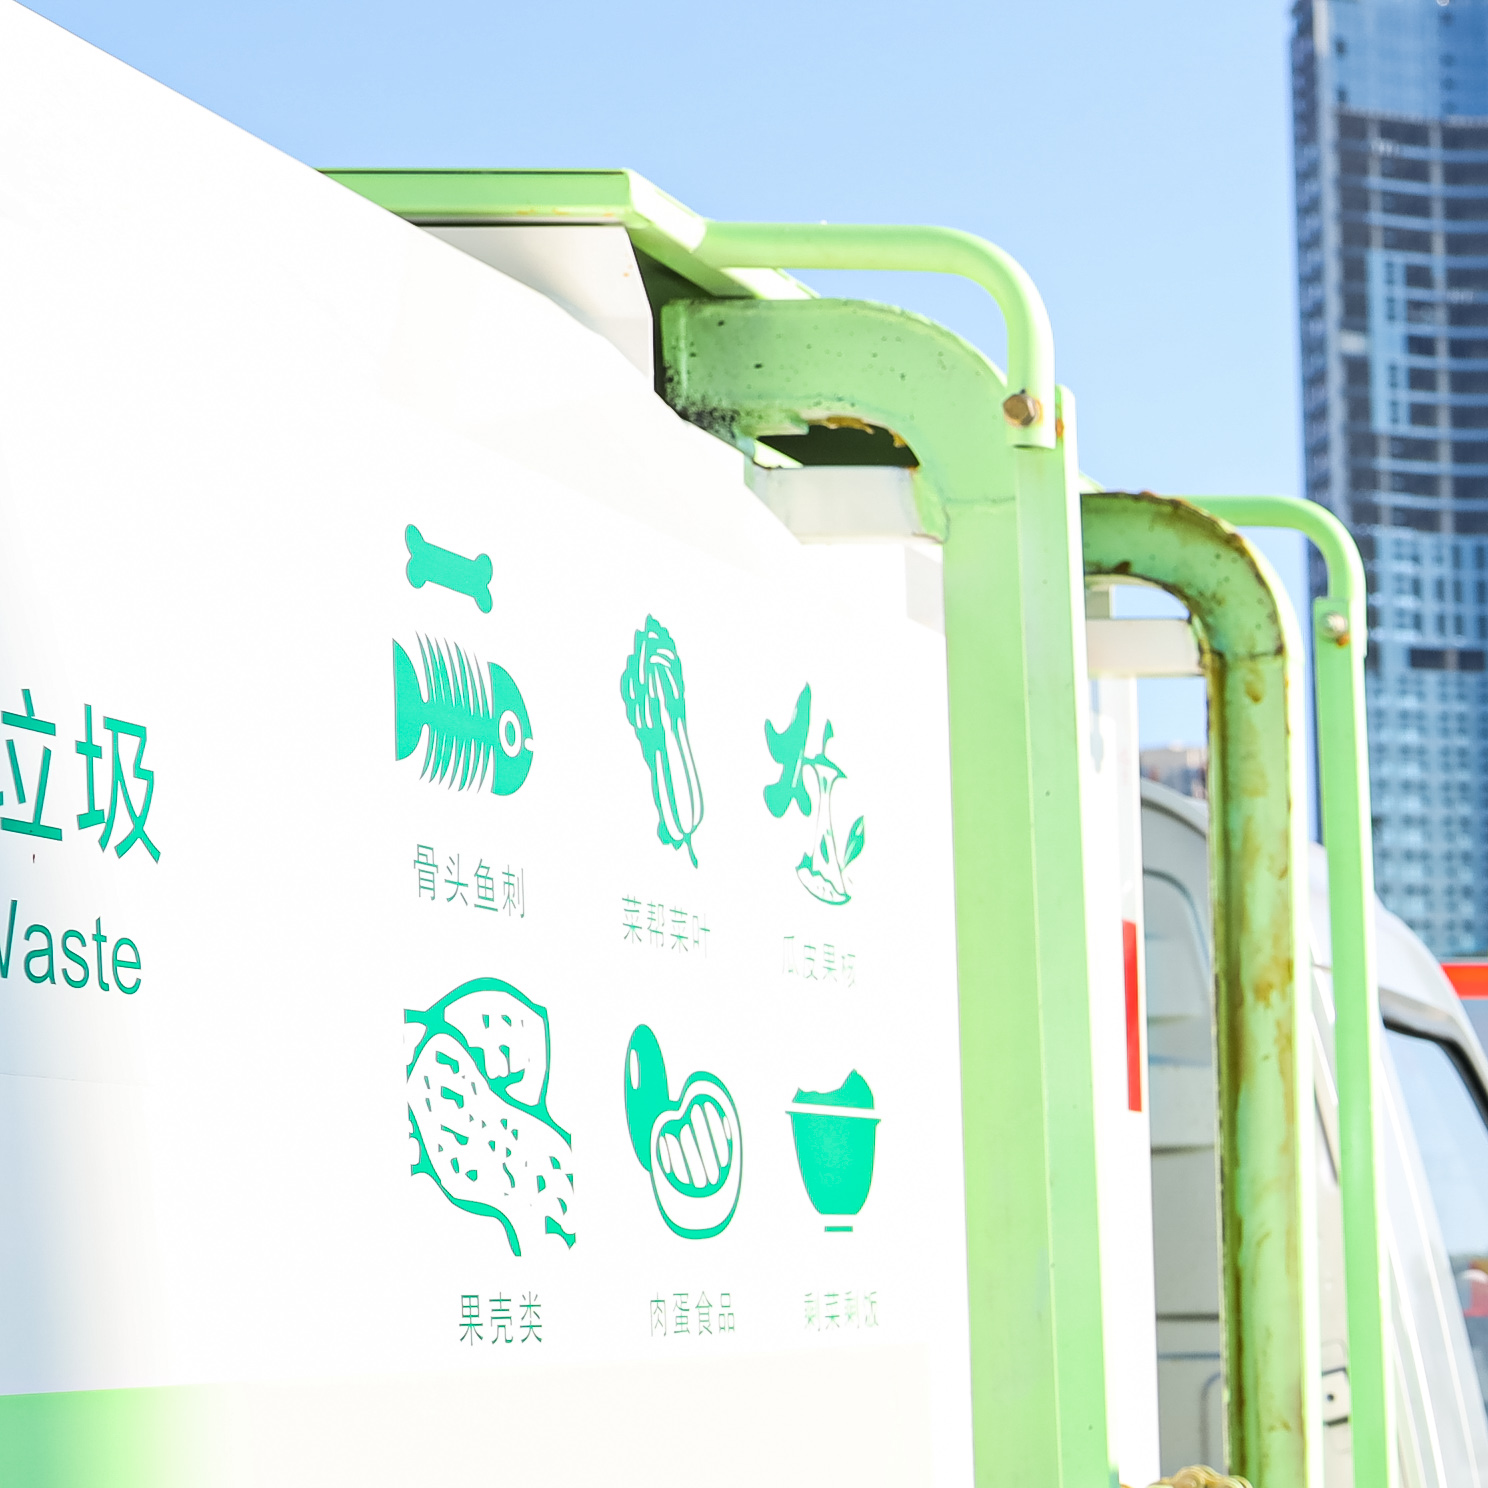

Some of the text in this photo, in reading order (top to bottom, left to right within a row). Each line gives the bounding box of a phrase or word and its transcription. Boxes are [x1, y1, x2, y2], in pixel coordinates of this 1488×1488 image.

[413, 844, 525, 918] 骨头鱼刺
[622, 894, 710, 958] 菜帮菜叶
[459, 1291, 542, 1346] 果壳类
[650, 1291, 735, 1337] 肉蛋食品
